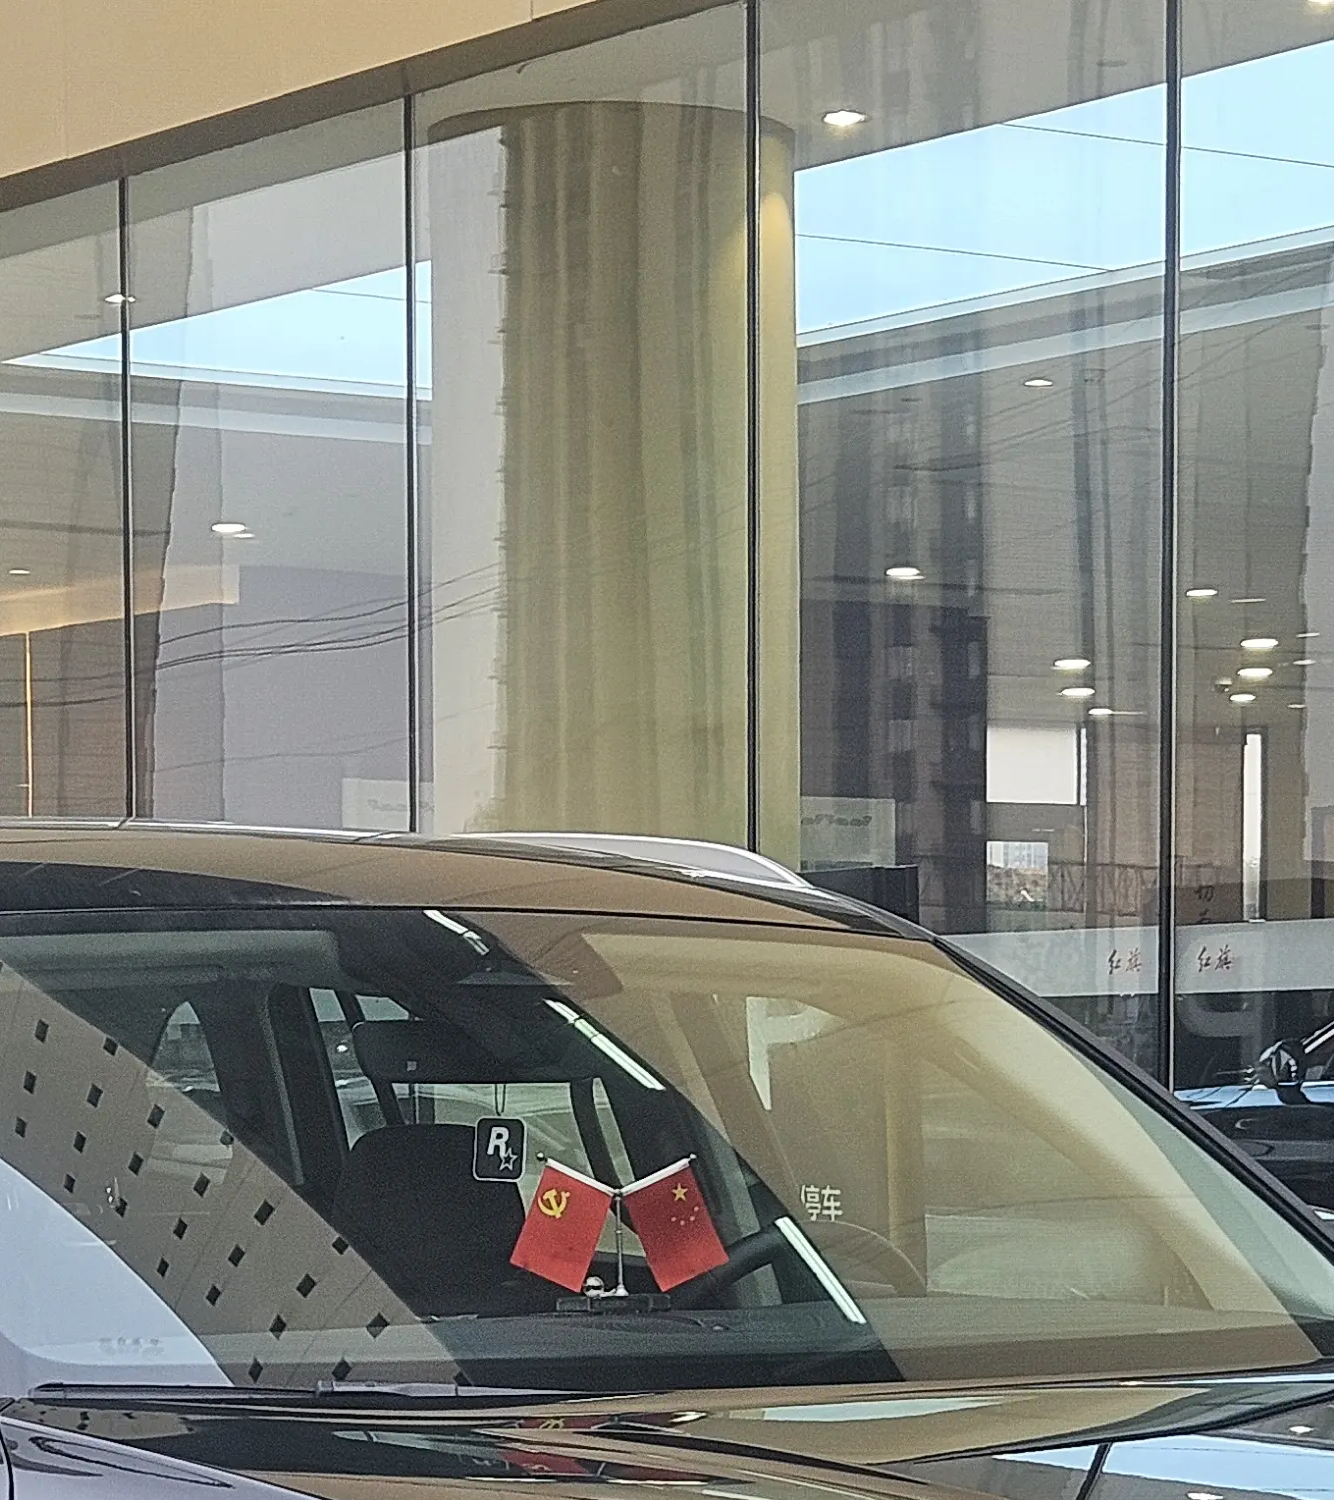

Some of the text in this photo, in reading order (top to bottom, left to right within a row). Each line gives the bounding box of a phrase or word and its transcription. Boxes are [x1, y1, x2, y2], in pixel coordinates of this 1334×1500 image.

[1107, 946, 1143, 976] 红旗
[1196, 943, 1233, 973] 红旗
[487, 1126, 509, 1158] R
[800, 1184, 844, 1222] 停车
